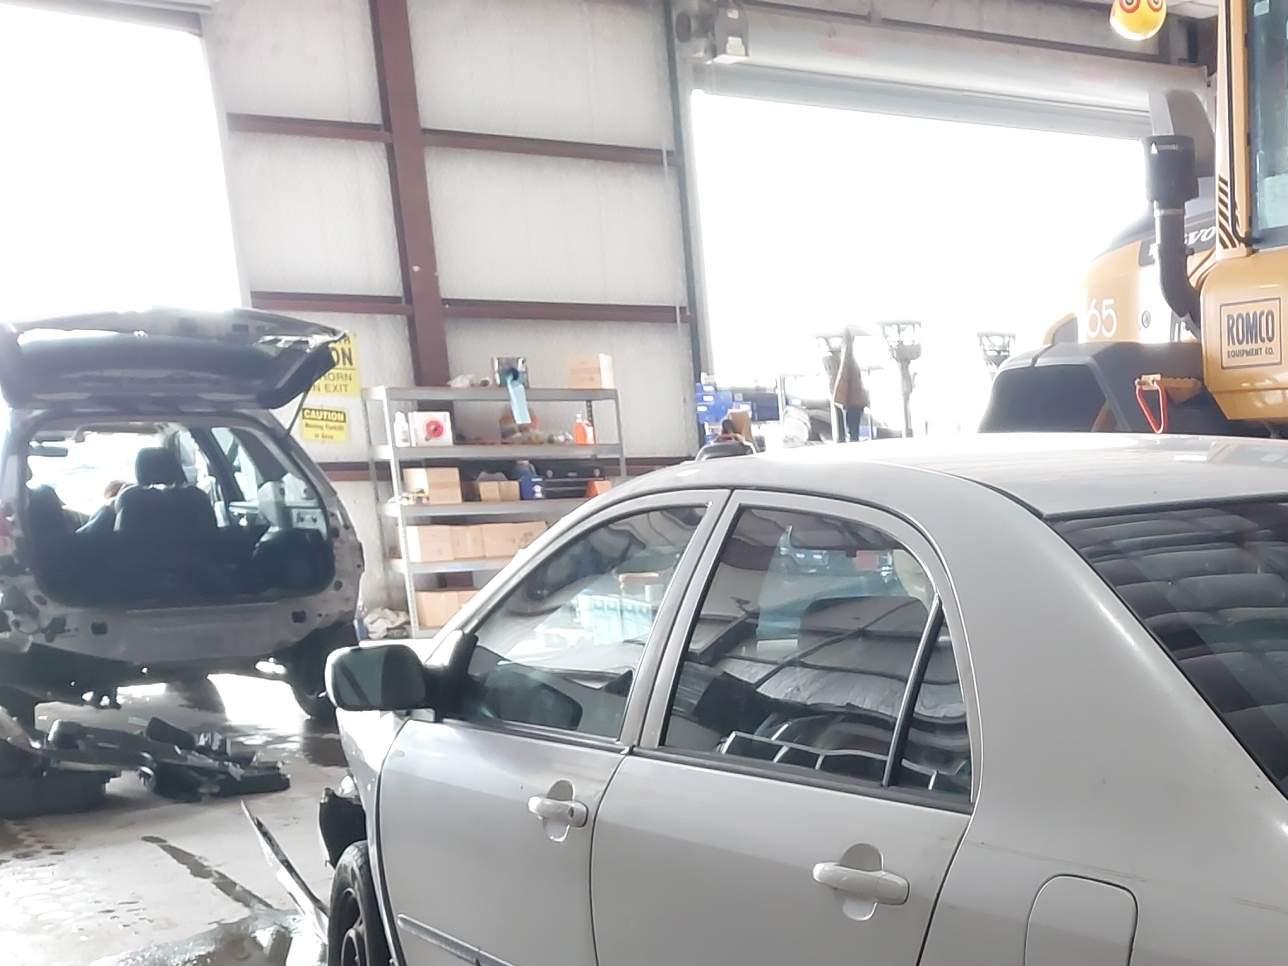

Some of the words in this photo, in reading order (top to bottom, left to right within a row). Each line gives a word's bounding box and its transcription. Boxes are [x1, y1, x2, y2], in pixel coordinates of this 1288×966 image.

[1087, 298, 1117, 338] 65
[1226, 310, 1275, 346] ROMCO
[303, 408, 345, 422] CAUTION
